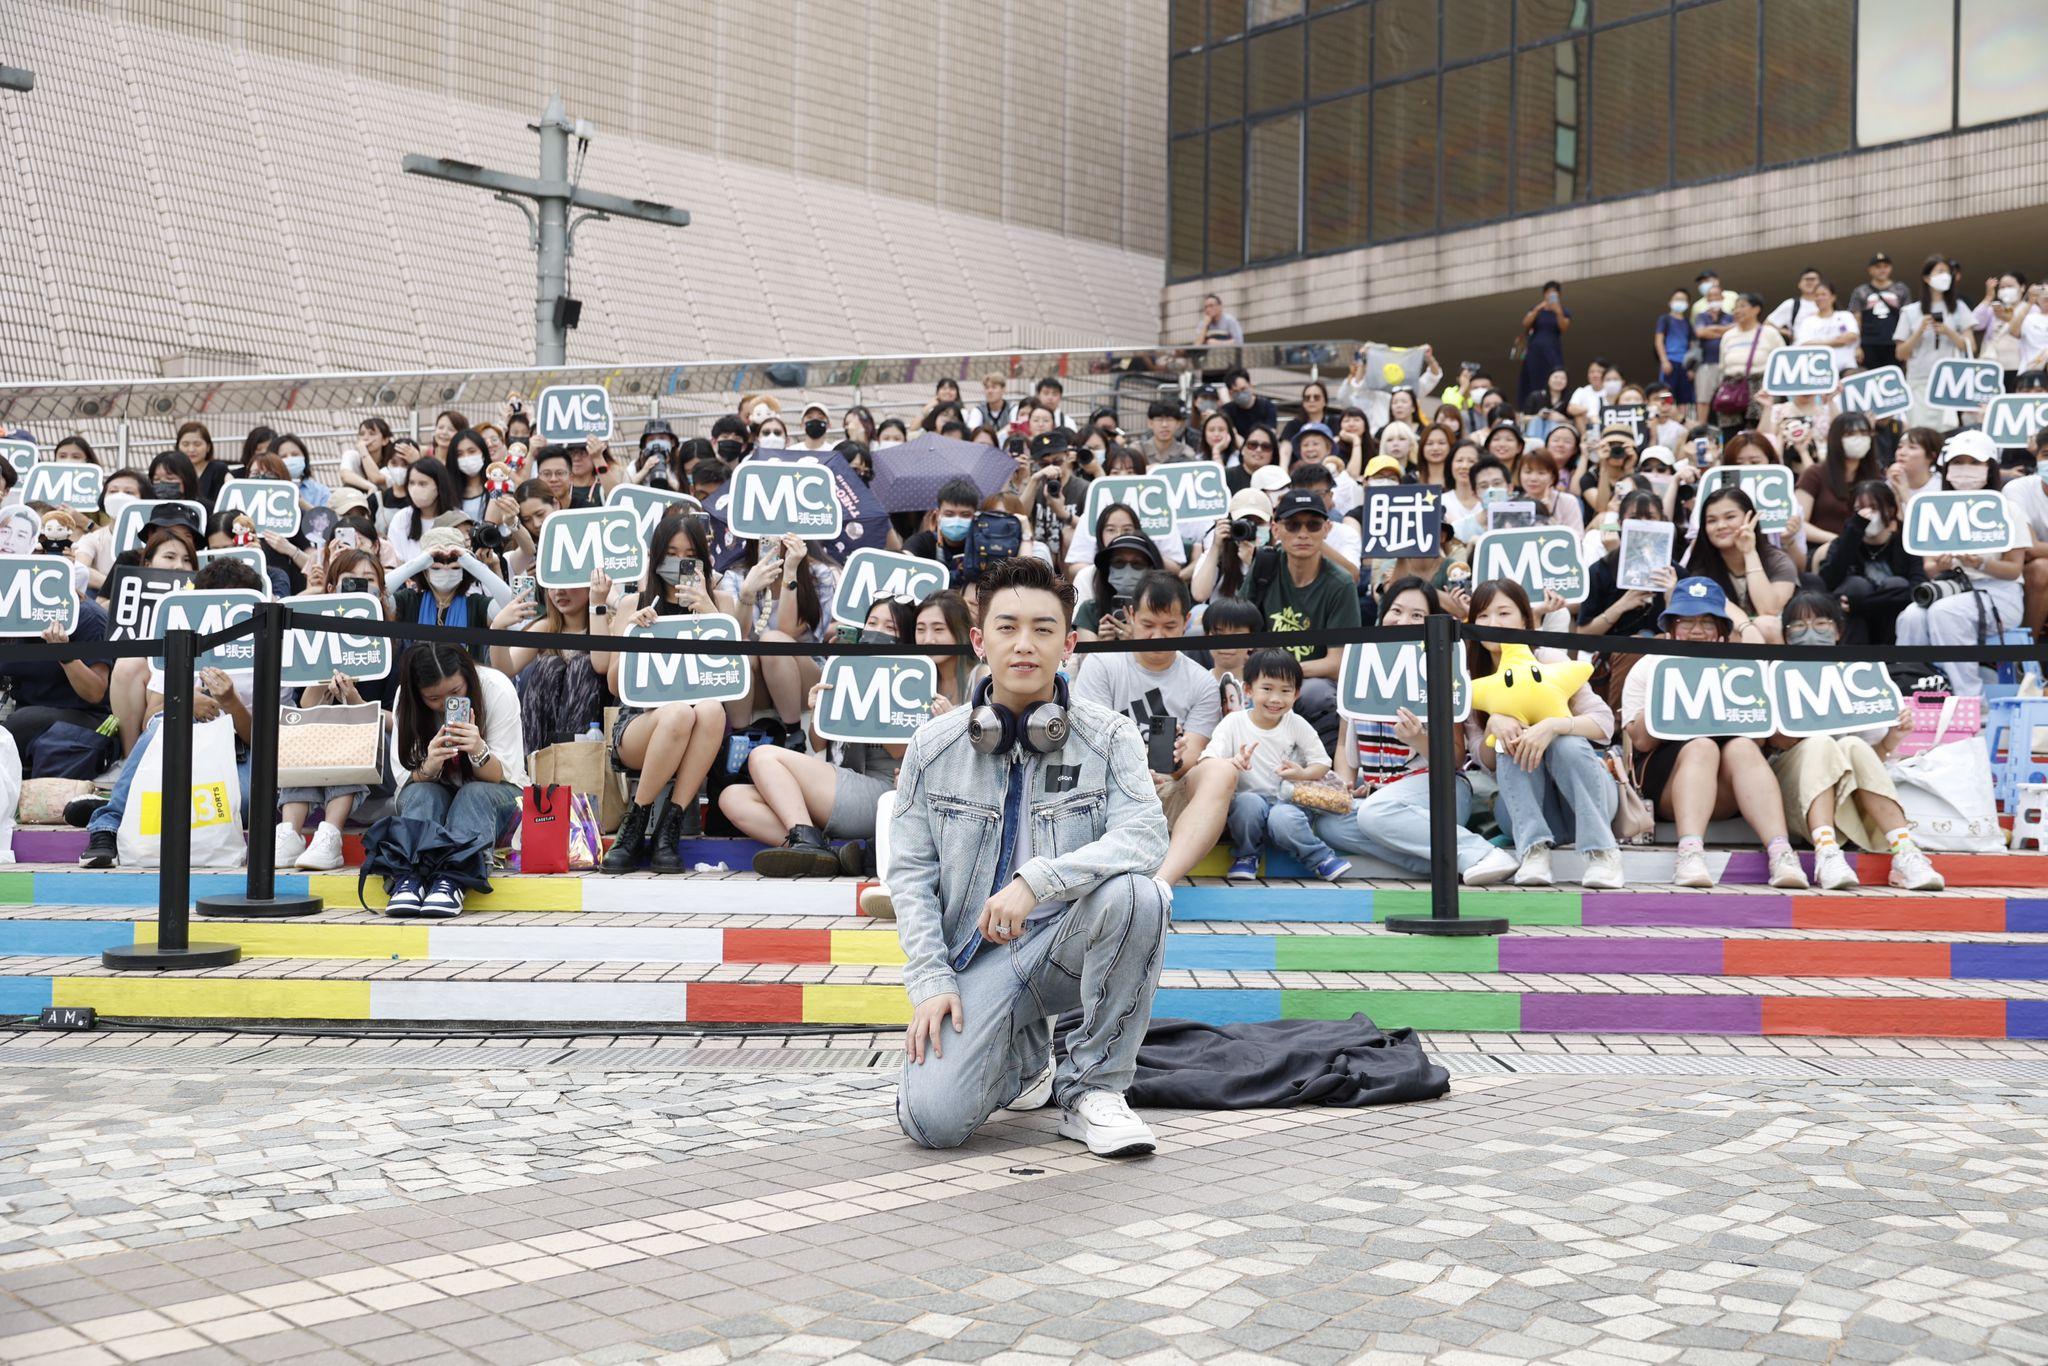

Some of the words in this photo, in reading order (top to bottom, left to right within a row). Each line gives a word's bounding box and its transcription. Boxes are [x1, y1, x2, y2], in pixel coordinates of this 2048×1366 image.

[1771, 353, 1829, 386] MC
[1935, 366, 1996, 400] MC
[546, 394, 602, 431] MC
[1845, 373, 1896, 411] MC
[30, 470, 96, 501] MC
[742, 473, 825, 522] MC
[1365, 492, 1434, 552] 賦
[1917, 500, 1997, 542] MC
[550, 518, 630, 573] MC
[1487, 538, 1570, 590] MC
[847, 561, 938, 608] MC
[32, 607, 69, 622] 張天賦
[225, 643, 255, 659] 張天
[282, 608, 371, 668] MC
[342, 650, 381, 665] 張天賦
[635, 628, 728, 688] MC
[699, 671, 739, 687] 張天賦
[830, 665, 925, 723] MC
[1355, 643, 1427, 702] M
[1661, 667, 1756, 721] MC
[1784, 662, 1876, 719] MC
[212, 786, 225, 818] SPORTS
